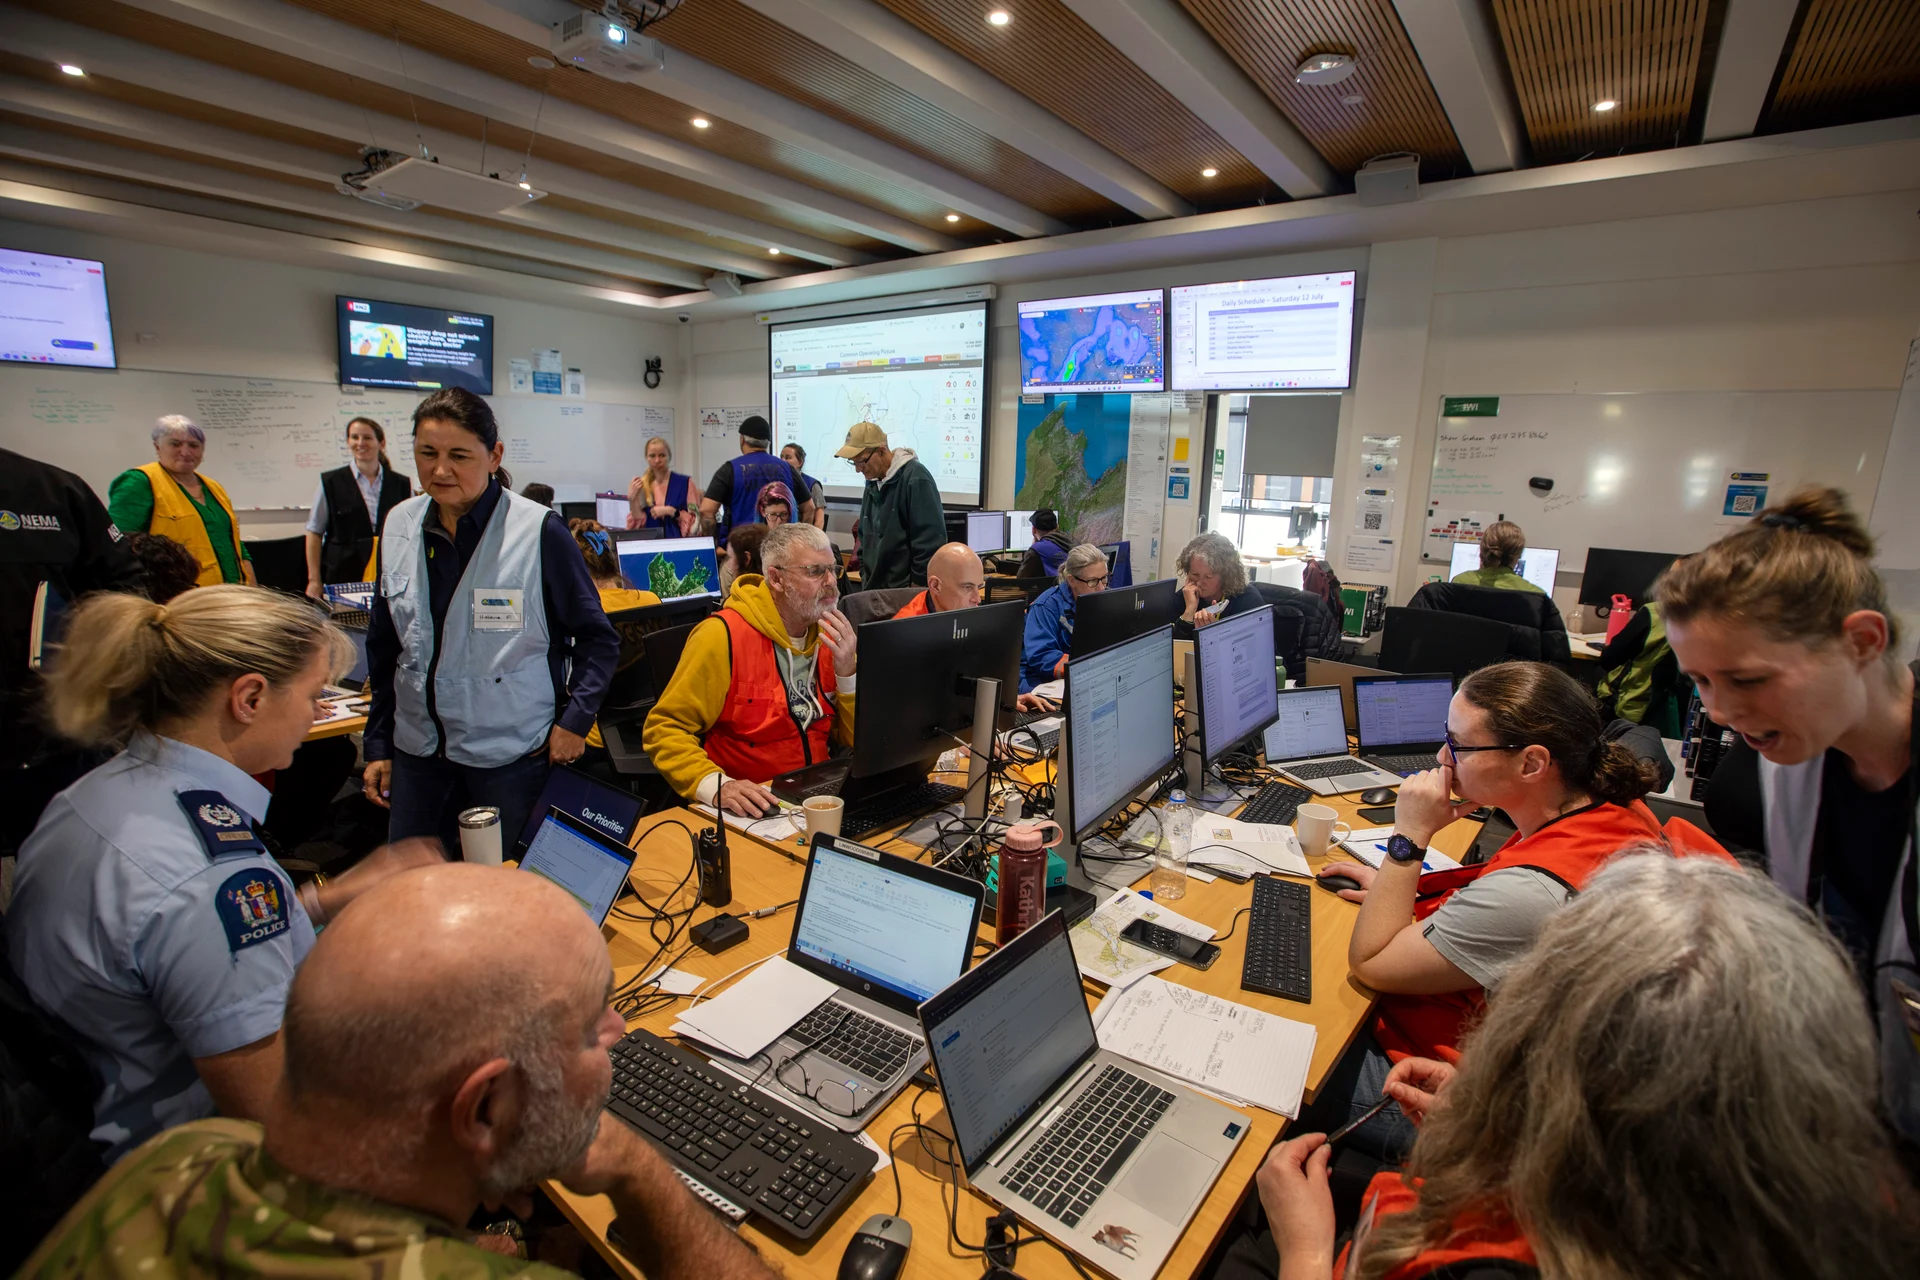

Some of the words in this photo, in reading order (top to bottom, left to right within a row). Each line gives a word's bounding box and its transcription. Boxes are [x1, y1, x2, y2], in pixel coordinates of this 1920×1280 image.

[0, 266, 41, 278] bjectives
[1238, 297, 1265, 306] Schedule
[1272, 294, 1300, 304] Saturday
[1311, 292, 1324, 301] July
[20, 514, 60, 527] NEMA
[582, 807, 595, 822] Our
[594, 814, 624, 835] Priorities
[1018, 876, 1035, 933] Kathm
[240, 920, 286, 944] POLICE
[863, 1237, 885, 1250] DELL
